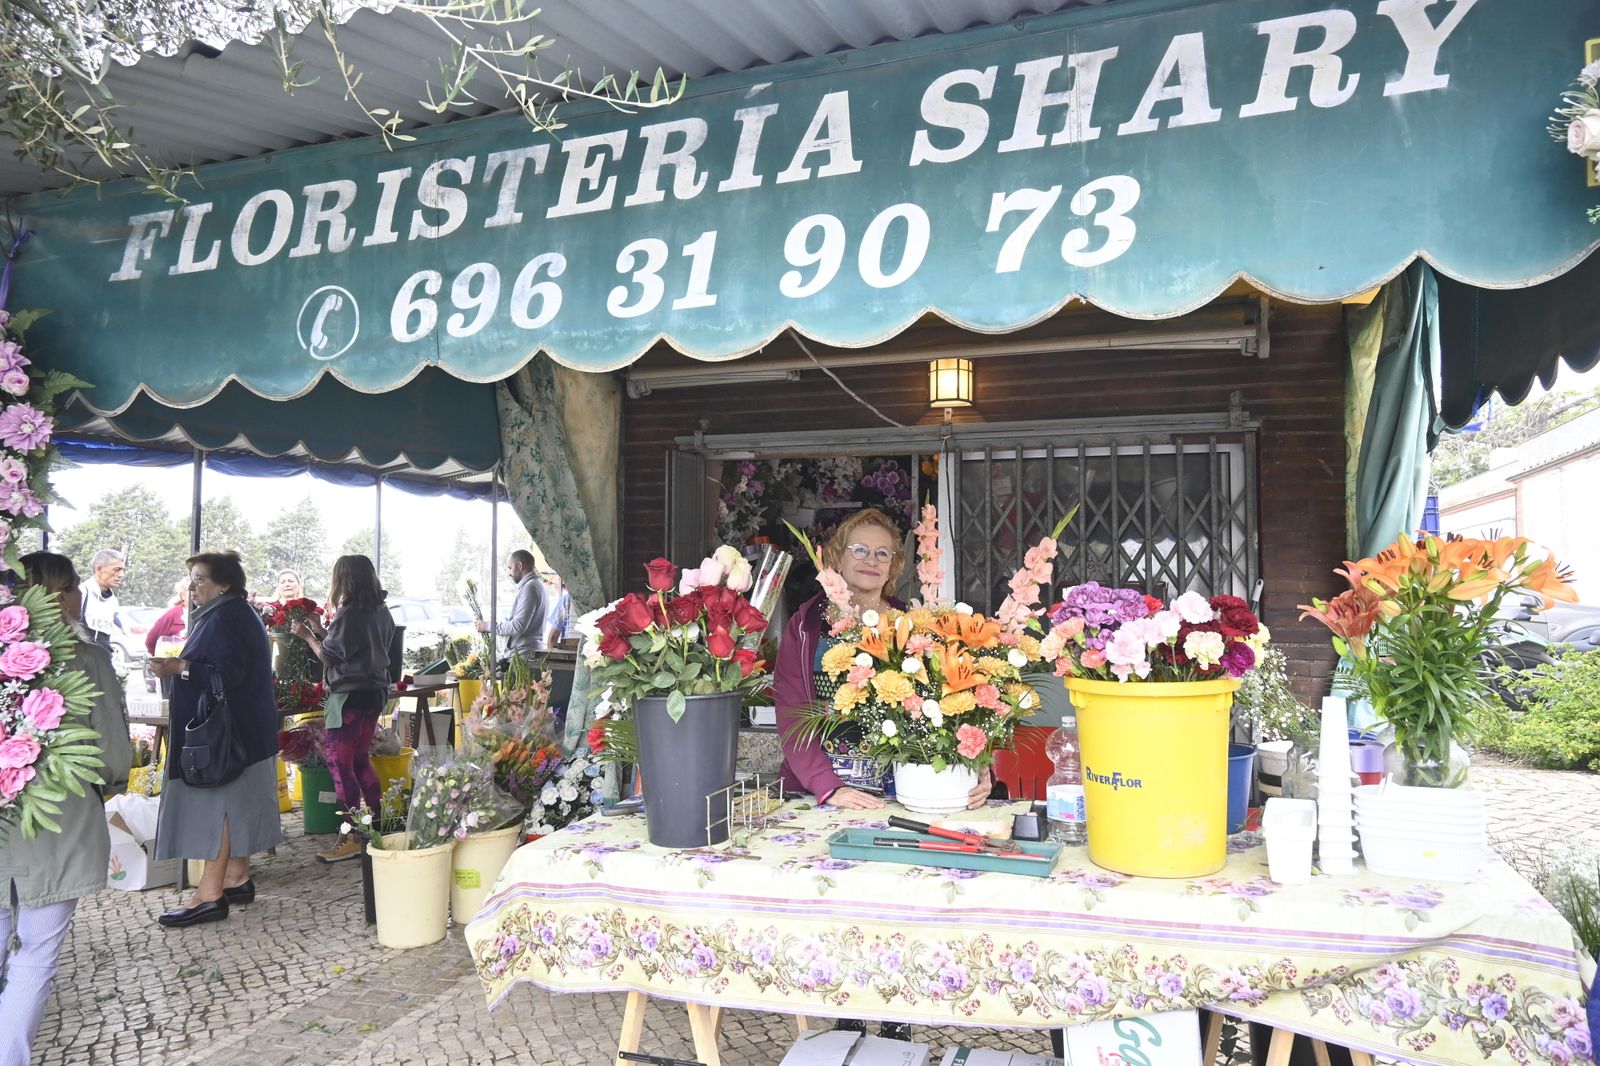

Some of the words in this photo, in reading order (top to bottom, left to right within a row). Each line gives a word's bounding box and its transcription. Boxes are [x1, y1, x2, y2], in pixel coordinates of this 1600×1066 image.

[108, 83, 864, 283] FLORISTERÍA
[909, 0, 1478, 167] SHARY
[389, 252, 568, 344] 696
[606, 230, 720, 319] 31
[779, 202, 931, 298] 90
[985, 174, 1141, 274] 73
